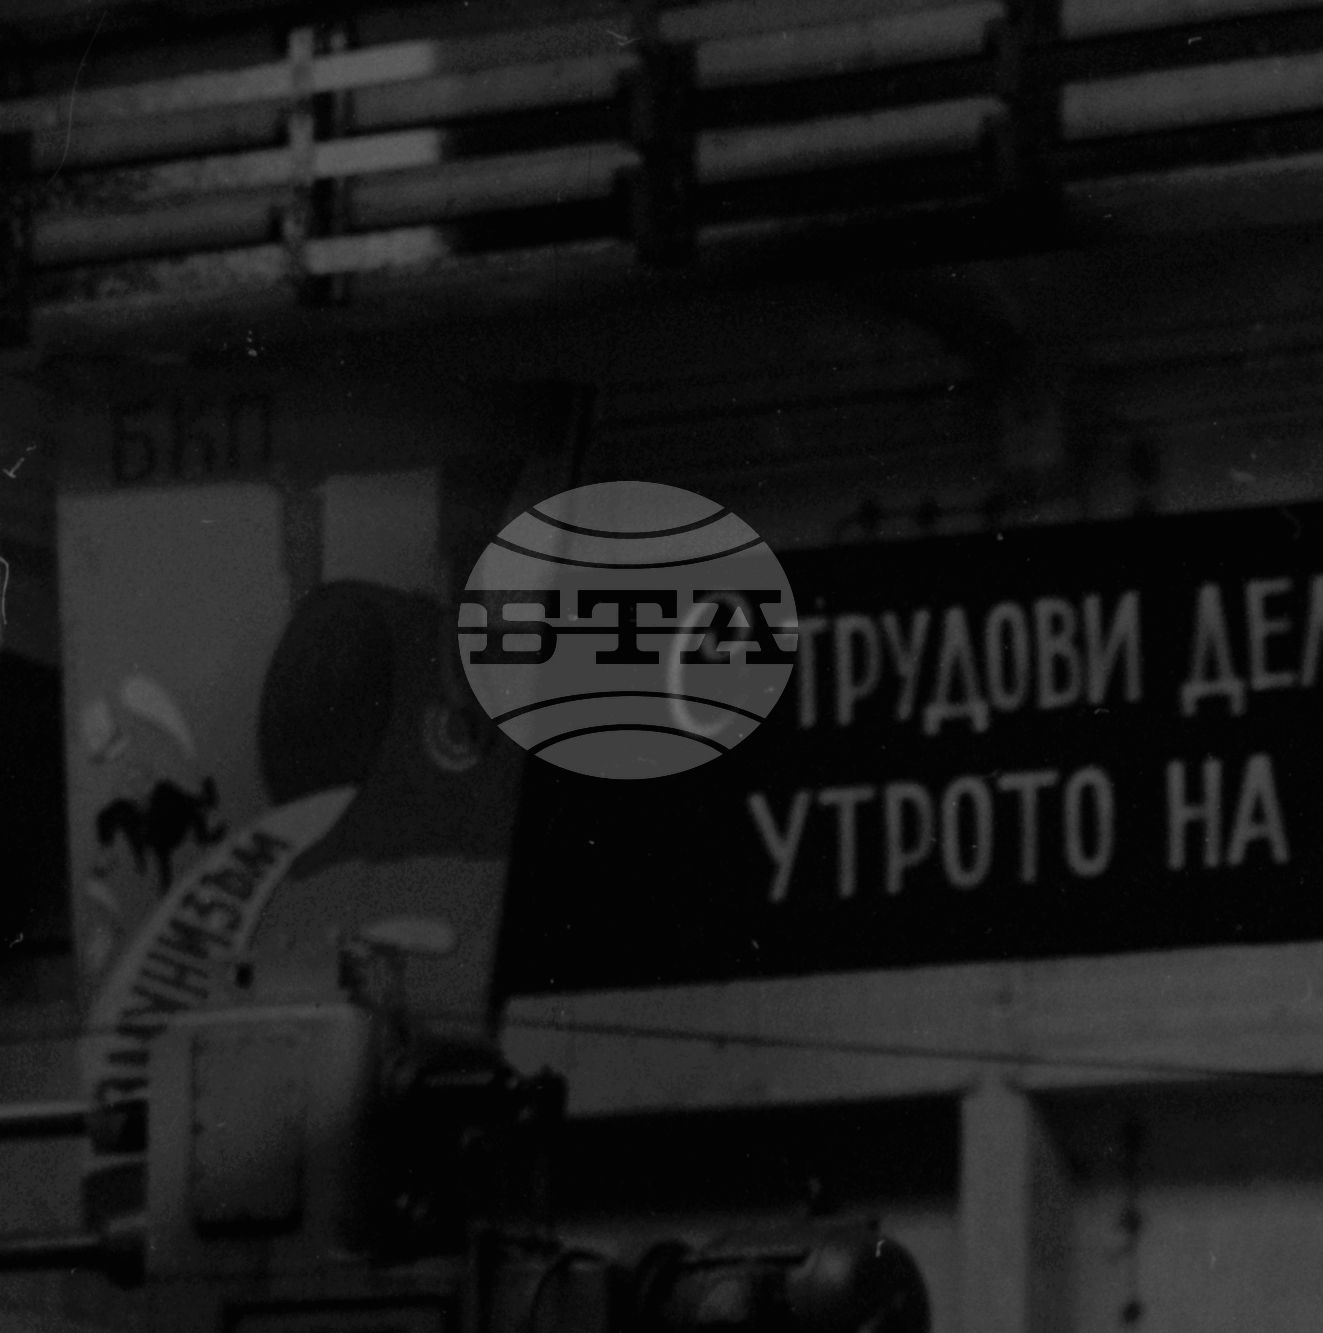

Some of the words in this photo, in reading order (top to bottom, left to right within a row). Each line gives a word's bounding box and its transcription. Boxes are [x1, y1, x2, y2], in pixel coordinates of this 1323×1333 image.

[111, 392, 272, 482] БКП
[745, 763, 1116, 904] УТРОТО
[1166, 750, 1291, 871] НА
